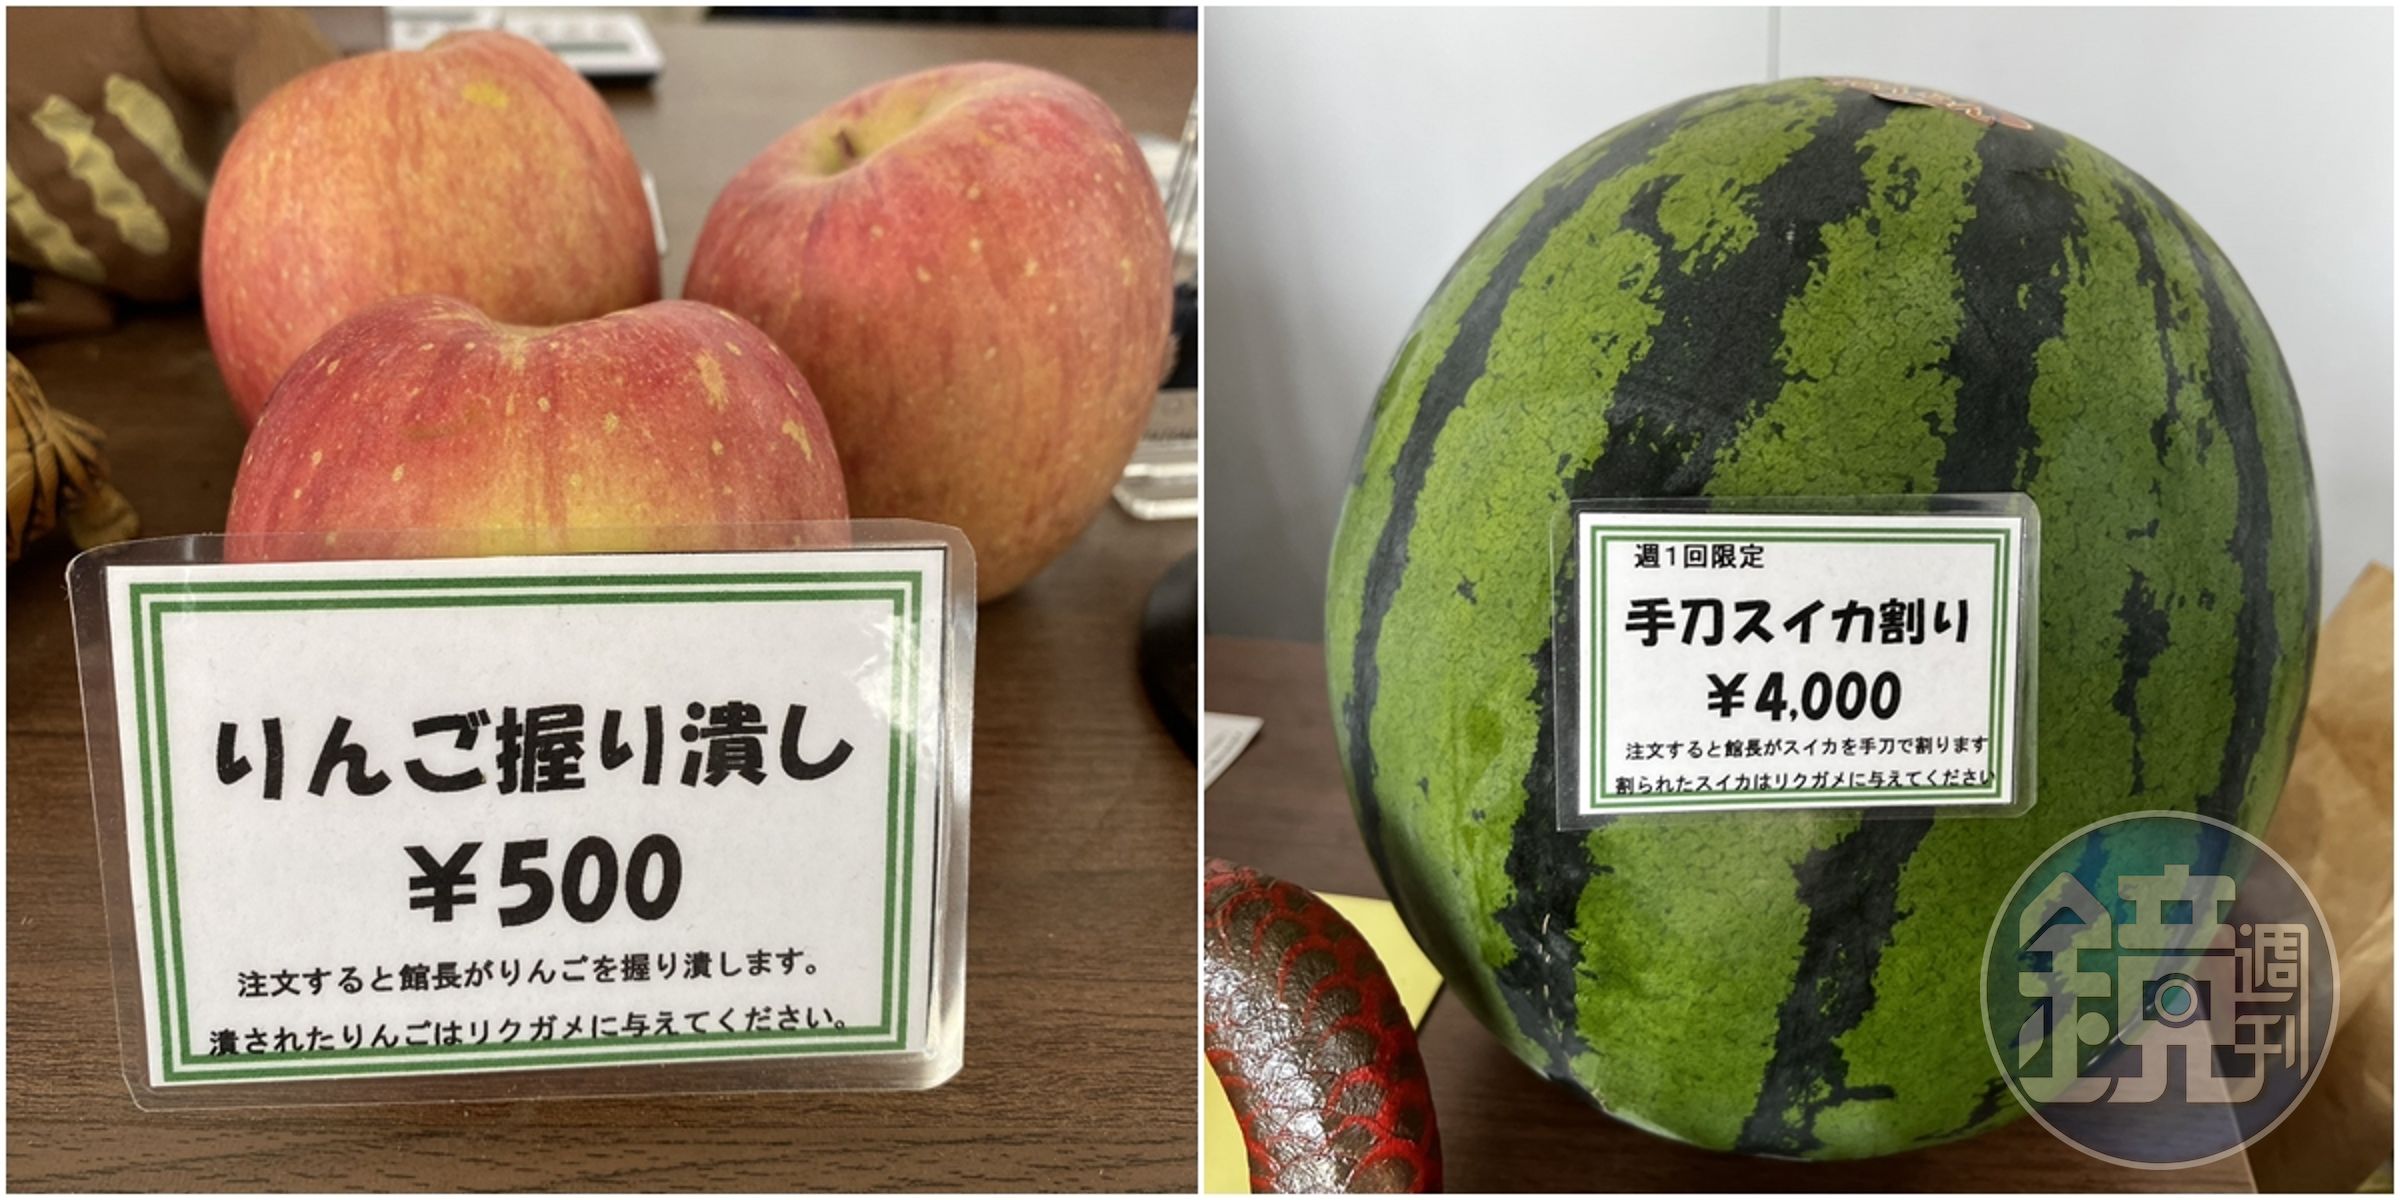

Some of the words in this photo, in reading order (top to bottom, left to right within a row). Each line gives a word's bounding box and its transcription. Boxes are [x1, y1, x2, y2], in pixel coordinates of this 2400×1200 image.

[1634, 543, 1765, 569] 週1回限定
[1625, 597, 1970, 647] 手刀スイカ割り
[1706, 671, 1902, 723] ¥4,000
[215, 700, 854, 800] りんご握り潰し
[1625, 735, 1989, 761] 注文すると館長がスイカを手刀で割ります
[1615, 768, 1996, 796] 割られたスイカはリクガメに与えてください
[403, 833, 684, 927] ¥500
[237, 947, 817, 998] 注文すると館長がりんごを握り潰します。
[208, 1004, 846, 1058] 潰されたりんごはリクガメに与えてください。
